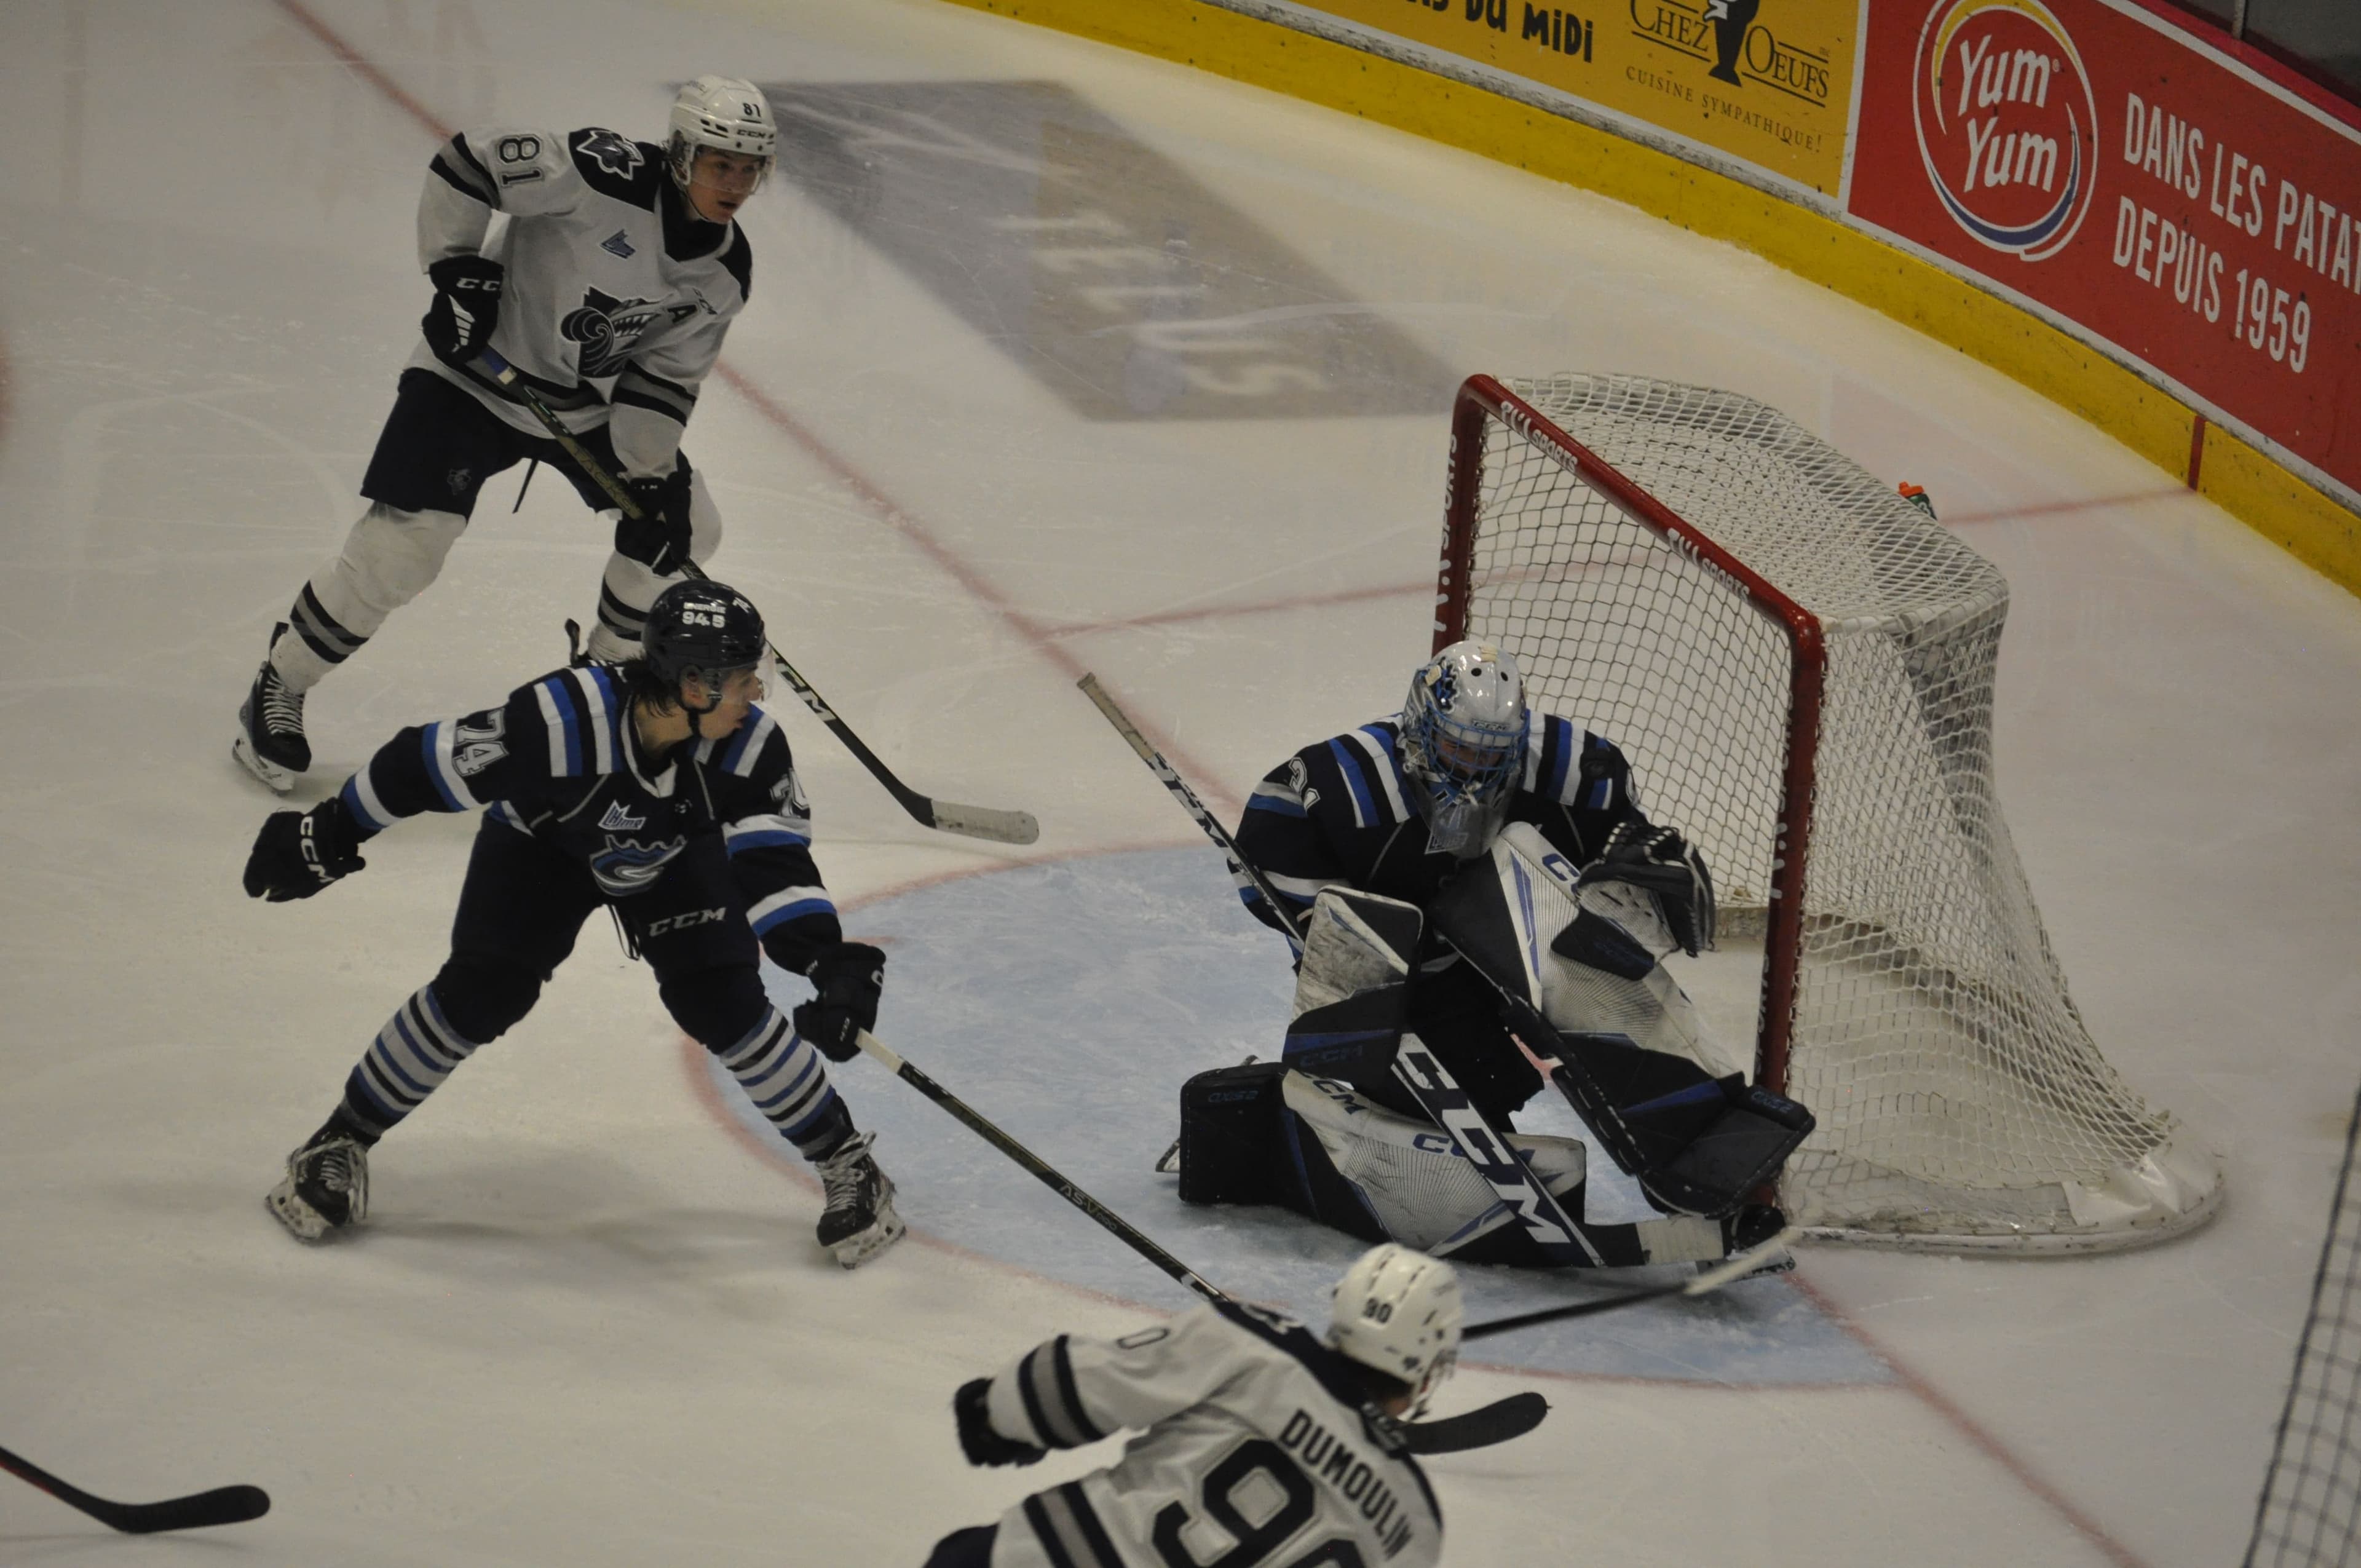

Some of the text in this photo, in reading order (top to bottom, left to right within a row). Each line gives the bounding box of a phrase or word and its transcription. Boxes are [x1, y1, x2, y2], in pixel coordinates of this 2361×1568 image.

[742, 103, 762, 117] 81
[1625, 65, 1822, 154] CUISINE SYMPATHIQUE!
[498, 133, 545, 188] 81
[1963, 117, 2058, 193] Yum
[2123, 92, 2204, 200] DANS
[2209, 143, 2267, 237] LES
[456, 277, 502, 291] CC
[2113, 195, 2311, 374] DEPUIS 1959
[299, 815, 336, 884] CCM
[648, 906, 727, 938] CCM
[1396, 1032, 1571, 1243] CCM
[1281, 1409, 1414, 1560] DUMOULIN
